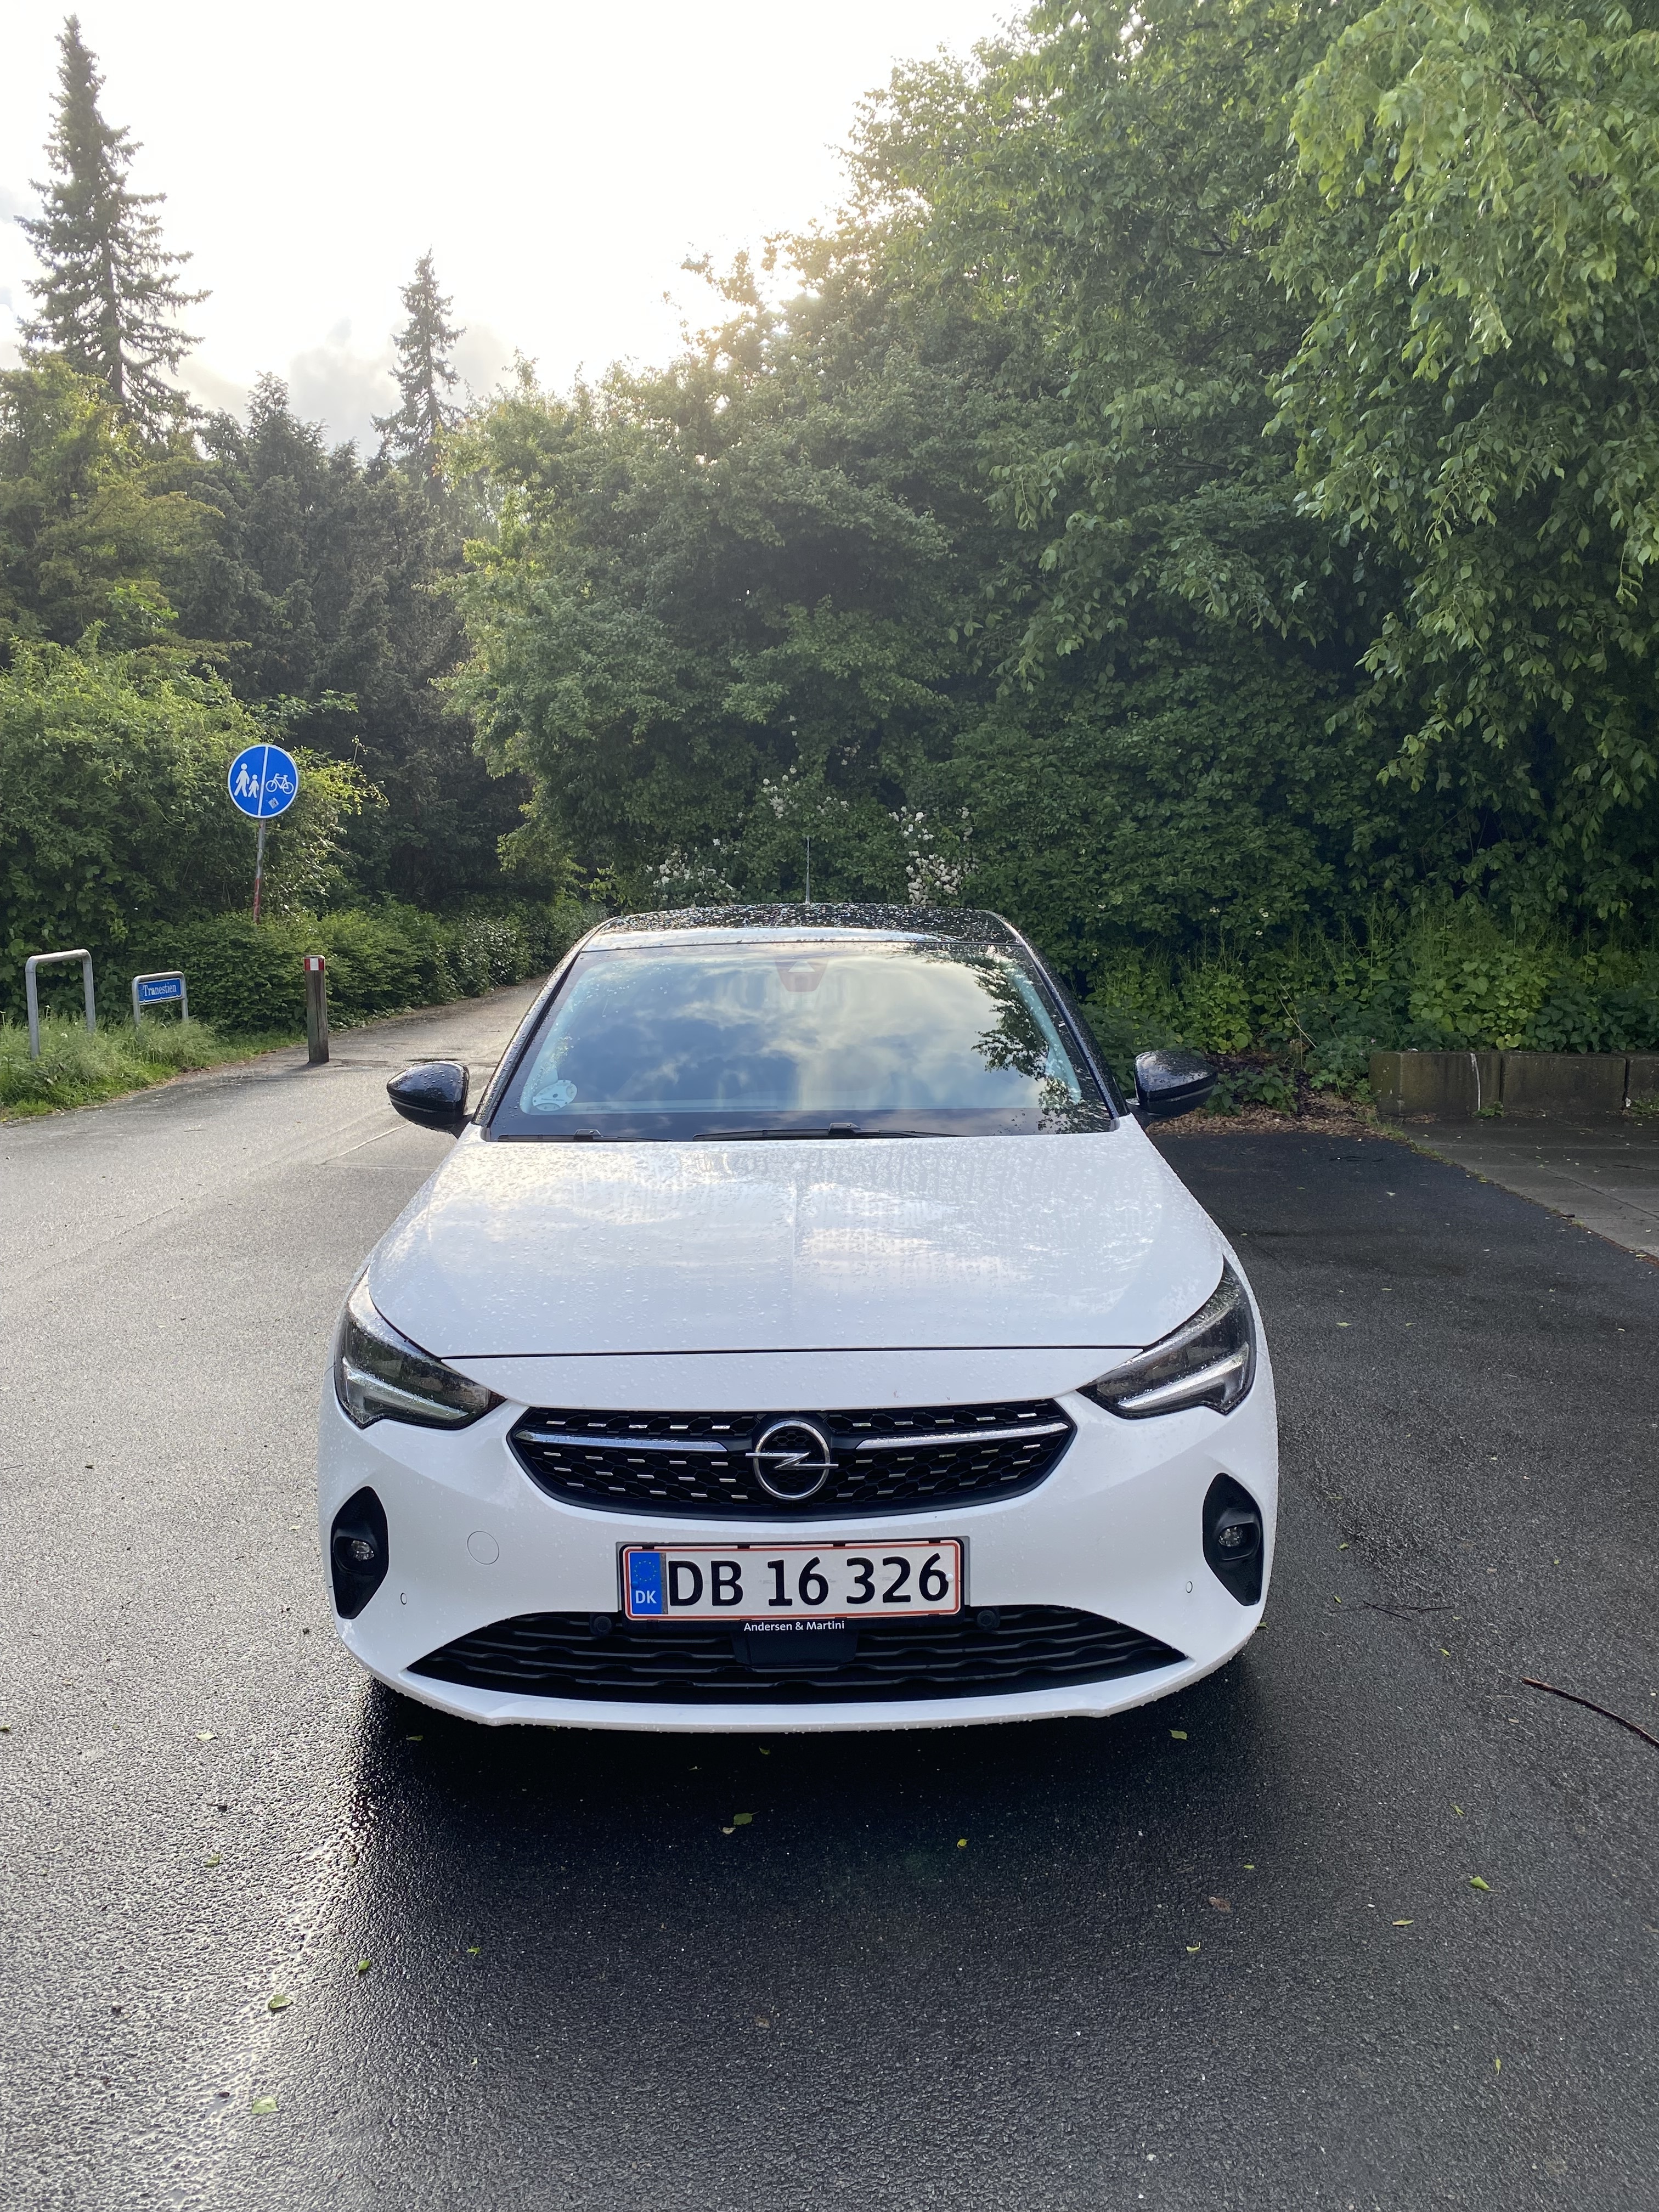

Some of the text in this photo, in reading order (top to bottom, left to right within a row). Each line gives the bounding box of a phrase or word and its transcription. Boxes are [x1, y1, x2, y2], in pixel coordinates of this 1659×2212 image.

[143, 982, 177, 996] Tranestien
[668, 1553, 949, 1606] DB 16 326
[635, 1590, 657, 1604] DK
[743, 1620, 844, 1632] Andersen & Martini
